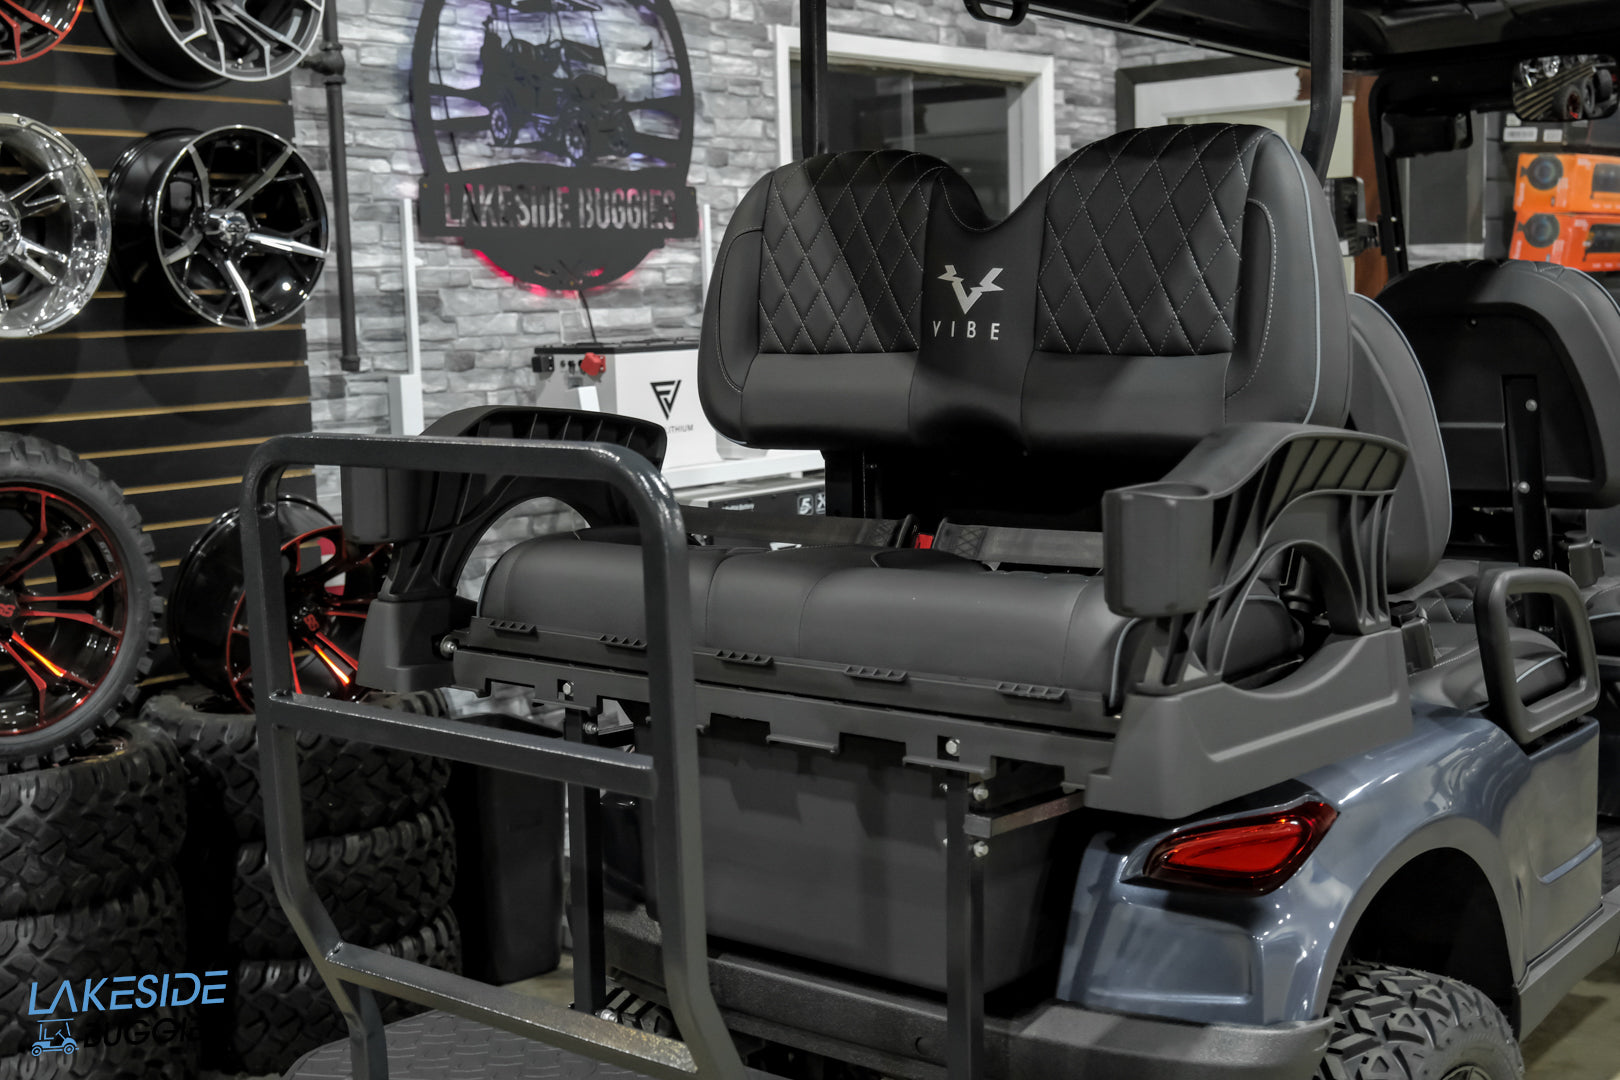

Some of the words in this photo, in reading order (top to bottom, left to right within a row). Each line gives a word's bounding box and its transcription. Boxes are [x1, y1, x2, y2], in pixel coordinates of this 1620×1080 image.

[444, 185, 572, 229] LAKESIDE
[578, 187, 676, 230] BUGGIES
[932, 320, 1001, 341] VIBE
